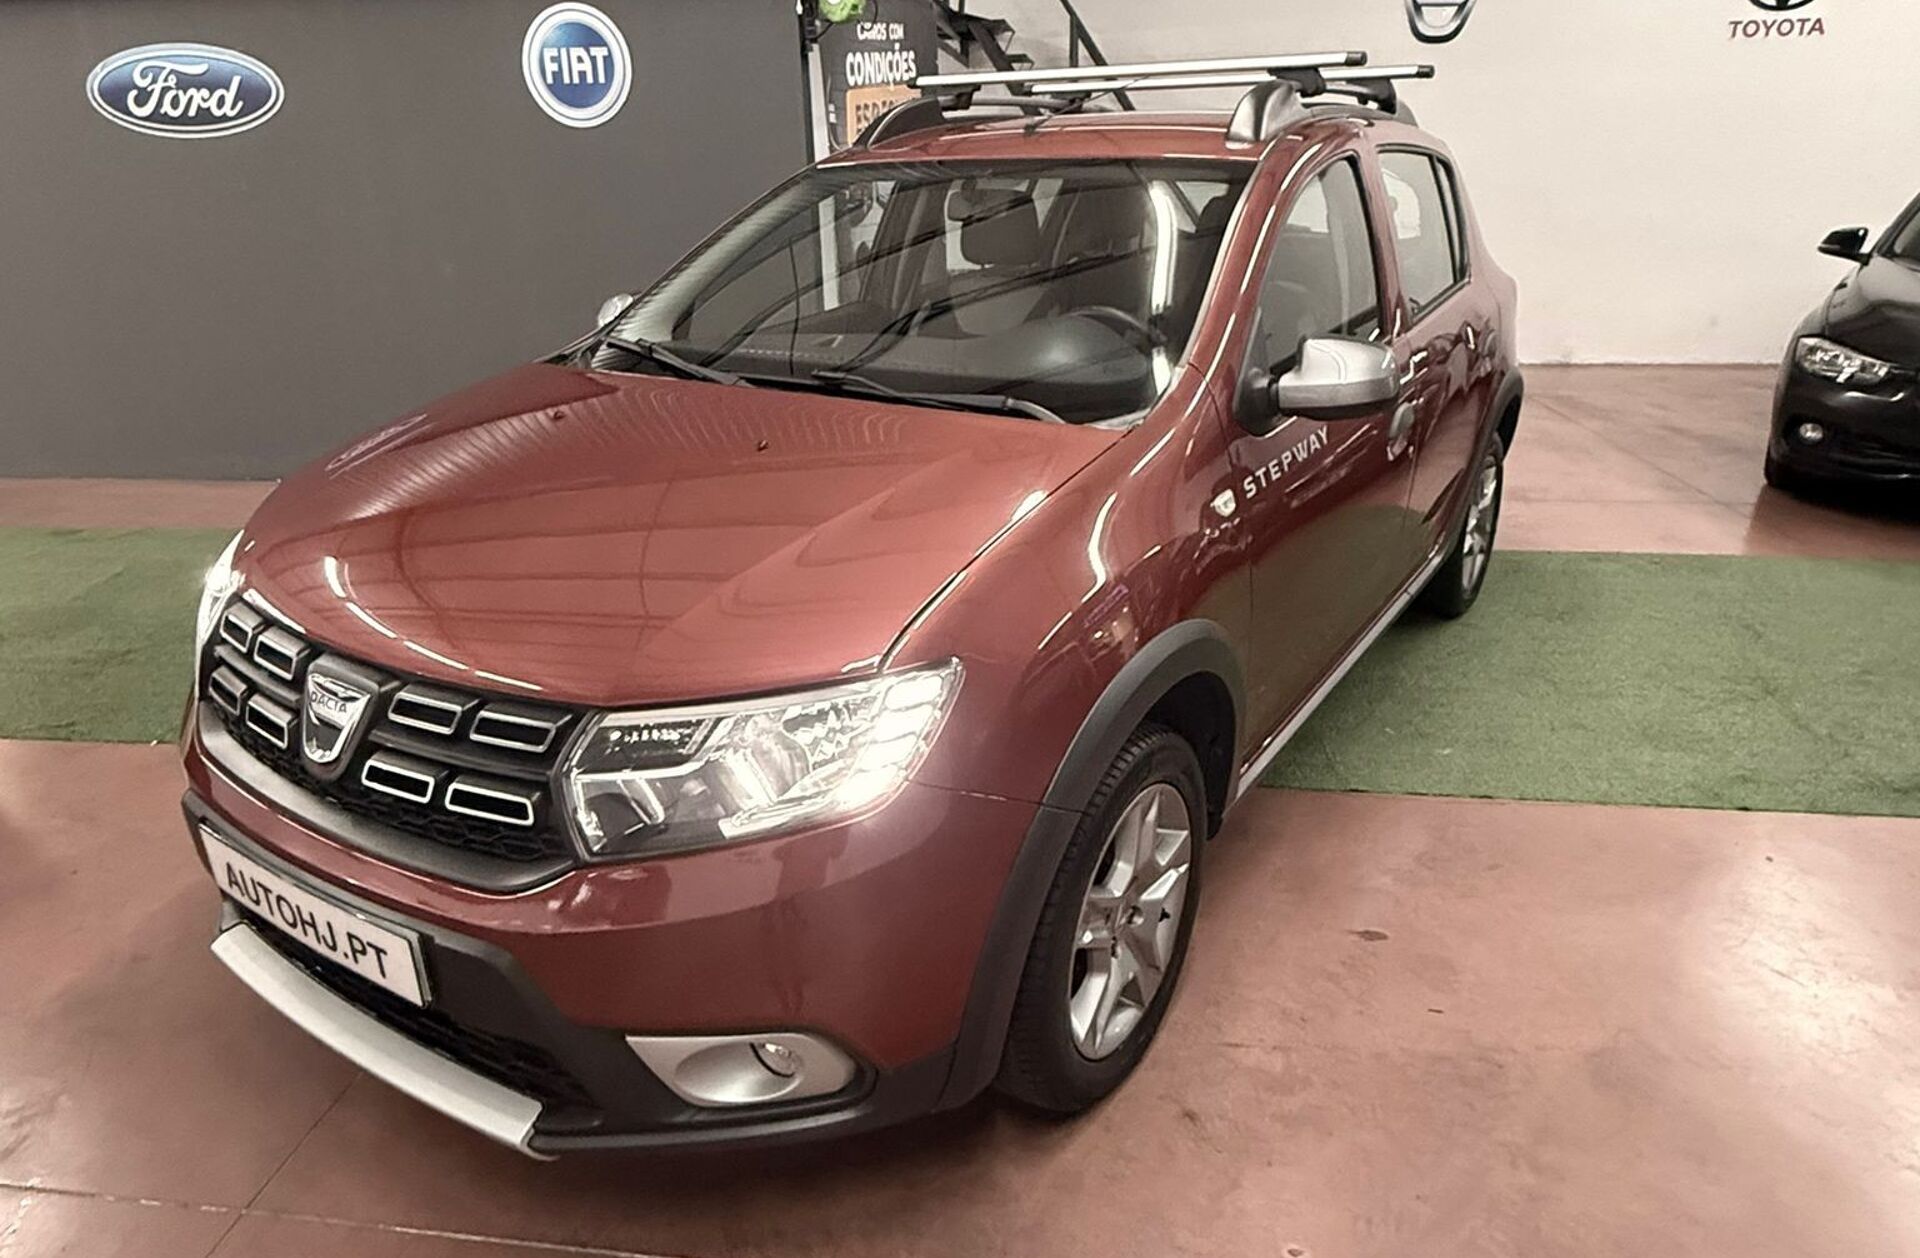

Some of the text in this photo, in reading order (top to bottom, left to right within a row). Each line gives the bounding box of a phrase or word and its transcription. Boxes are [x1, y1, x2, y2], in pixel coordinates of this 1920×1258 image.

[1728, 17, 1825, 39] TOYOTA
[127, 60, 244, 118] Ford
[543, 46, 609, 85] FIAT
[1243, 424, 1329, 499] STEPWAY
[310, 690, 347, 713] DACIA
[226, 861, 388, 979] AUTOHJ.PT
